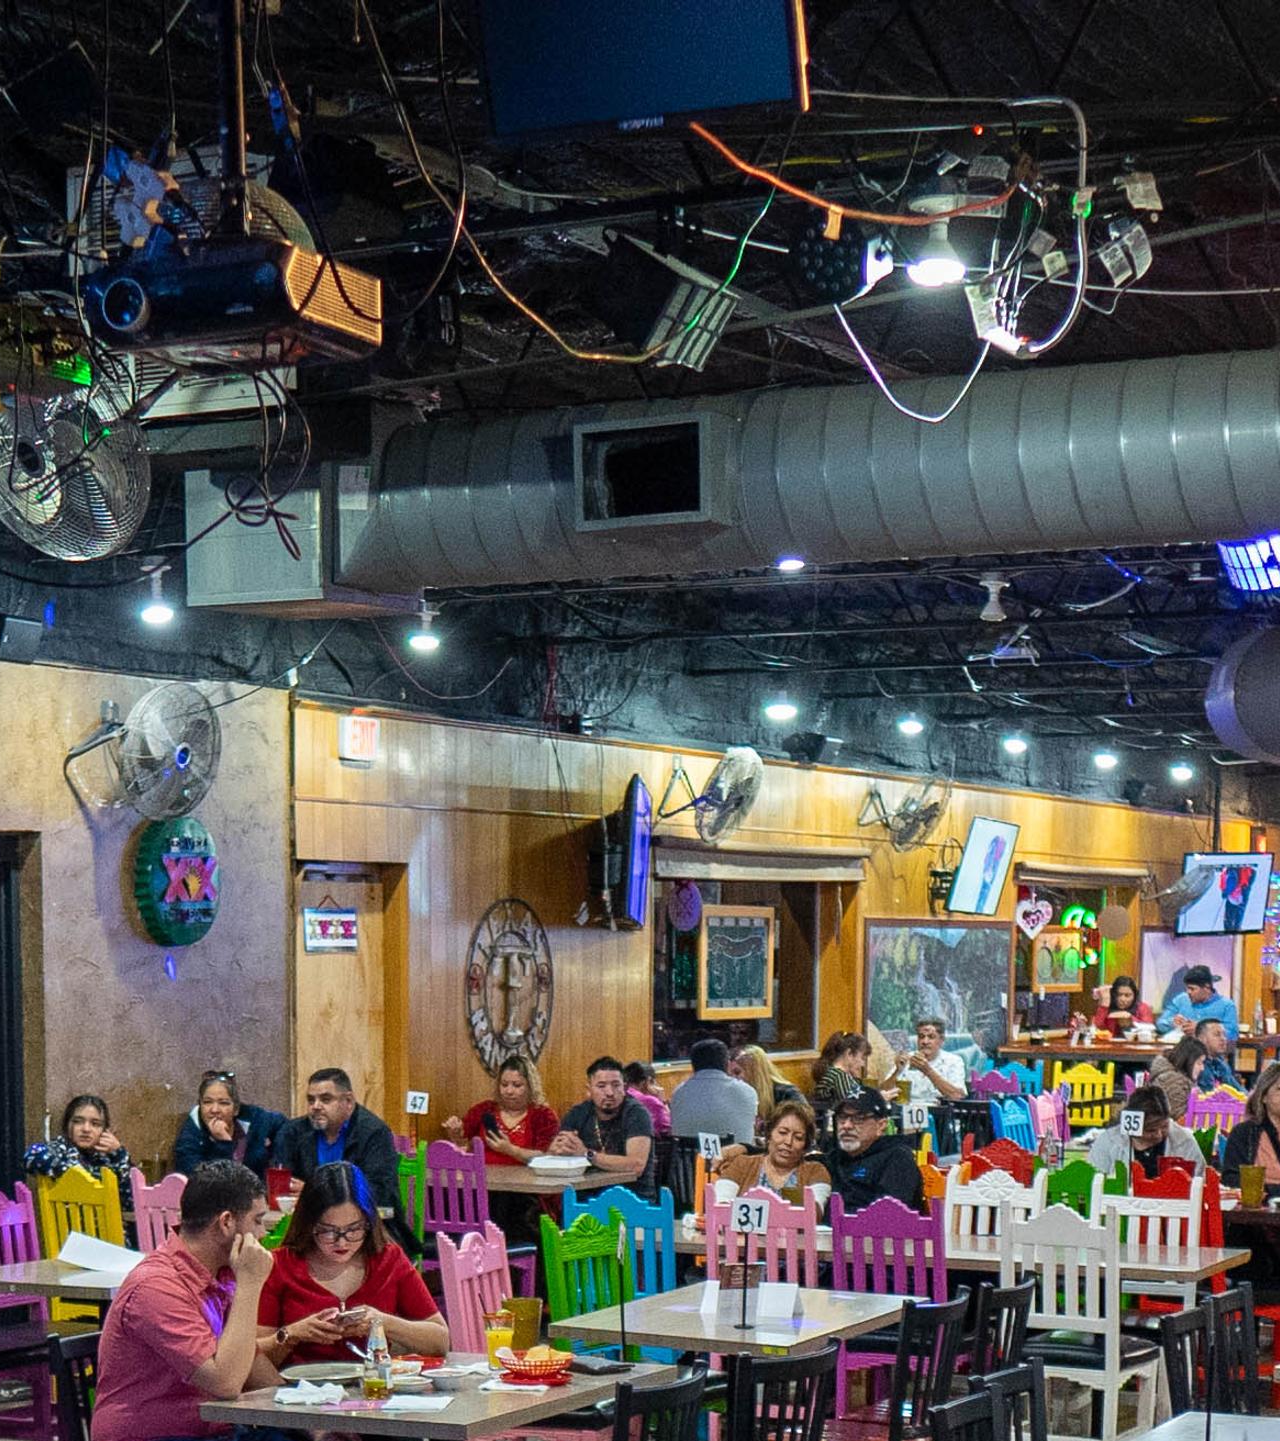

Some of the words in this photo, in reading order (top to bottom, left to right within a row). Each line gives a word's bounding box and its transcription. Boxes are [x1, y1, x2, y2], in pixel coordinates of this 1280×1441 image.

[410, 1096, 426, 1109] 47
[908, 1109, 924, 1124] 10
[1124, 1115, 1140, 1131] 35
[704, 1138, 718, 1155] 41
[738, 1203, 763, 1228] 31
